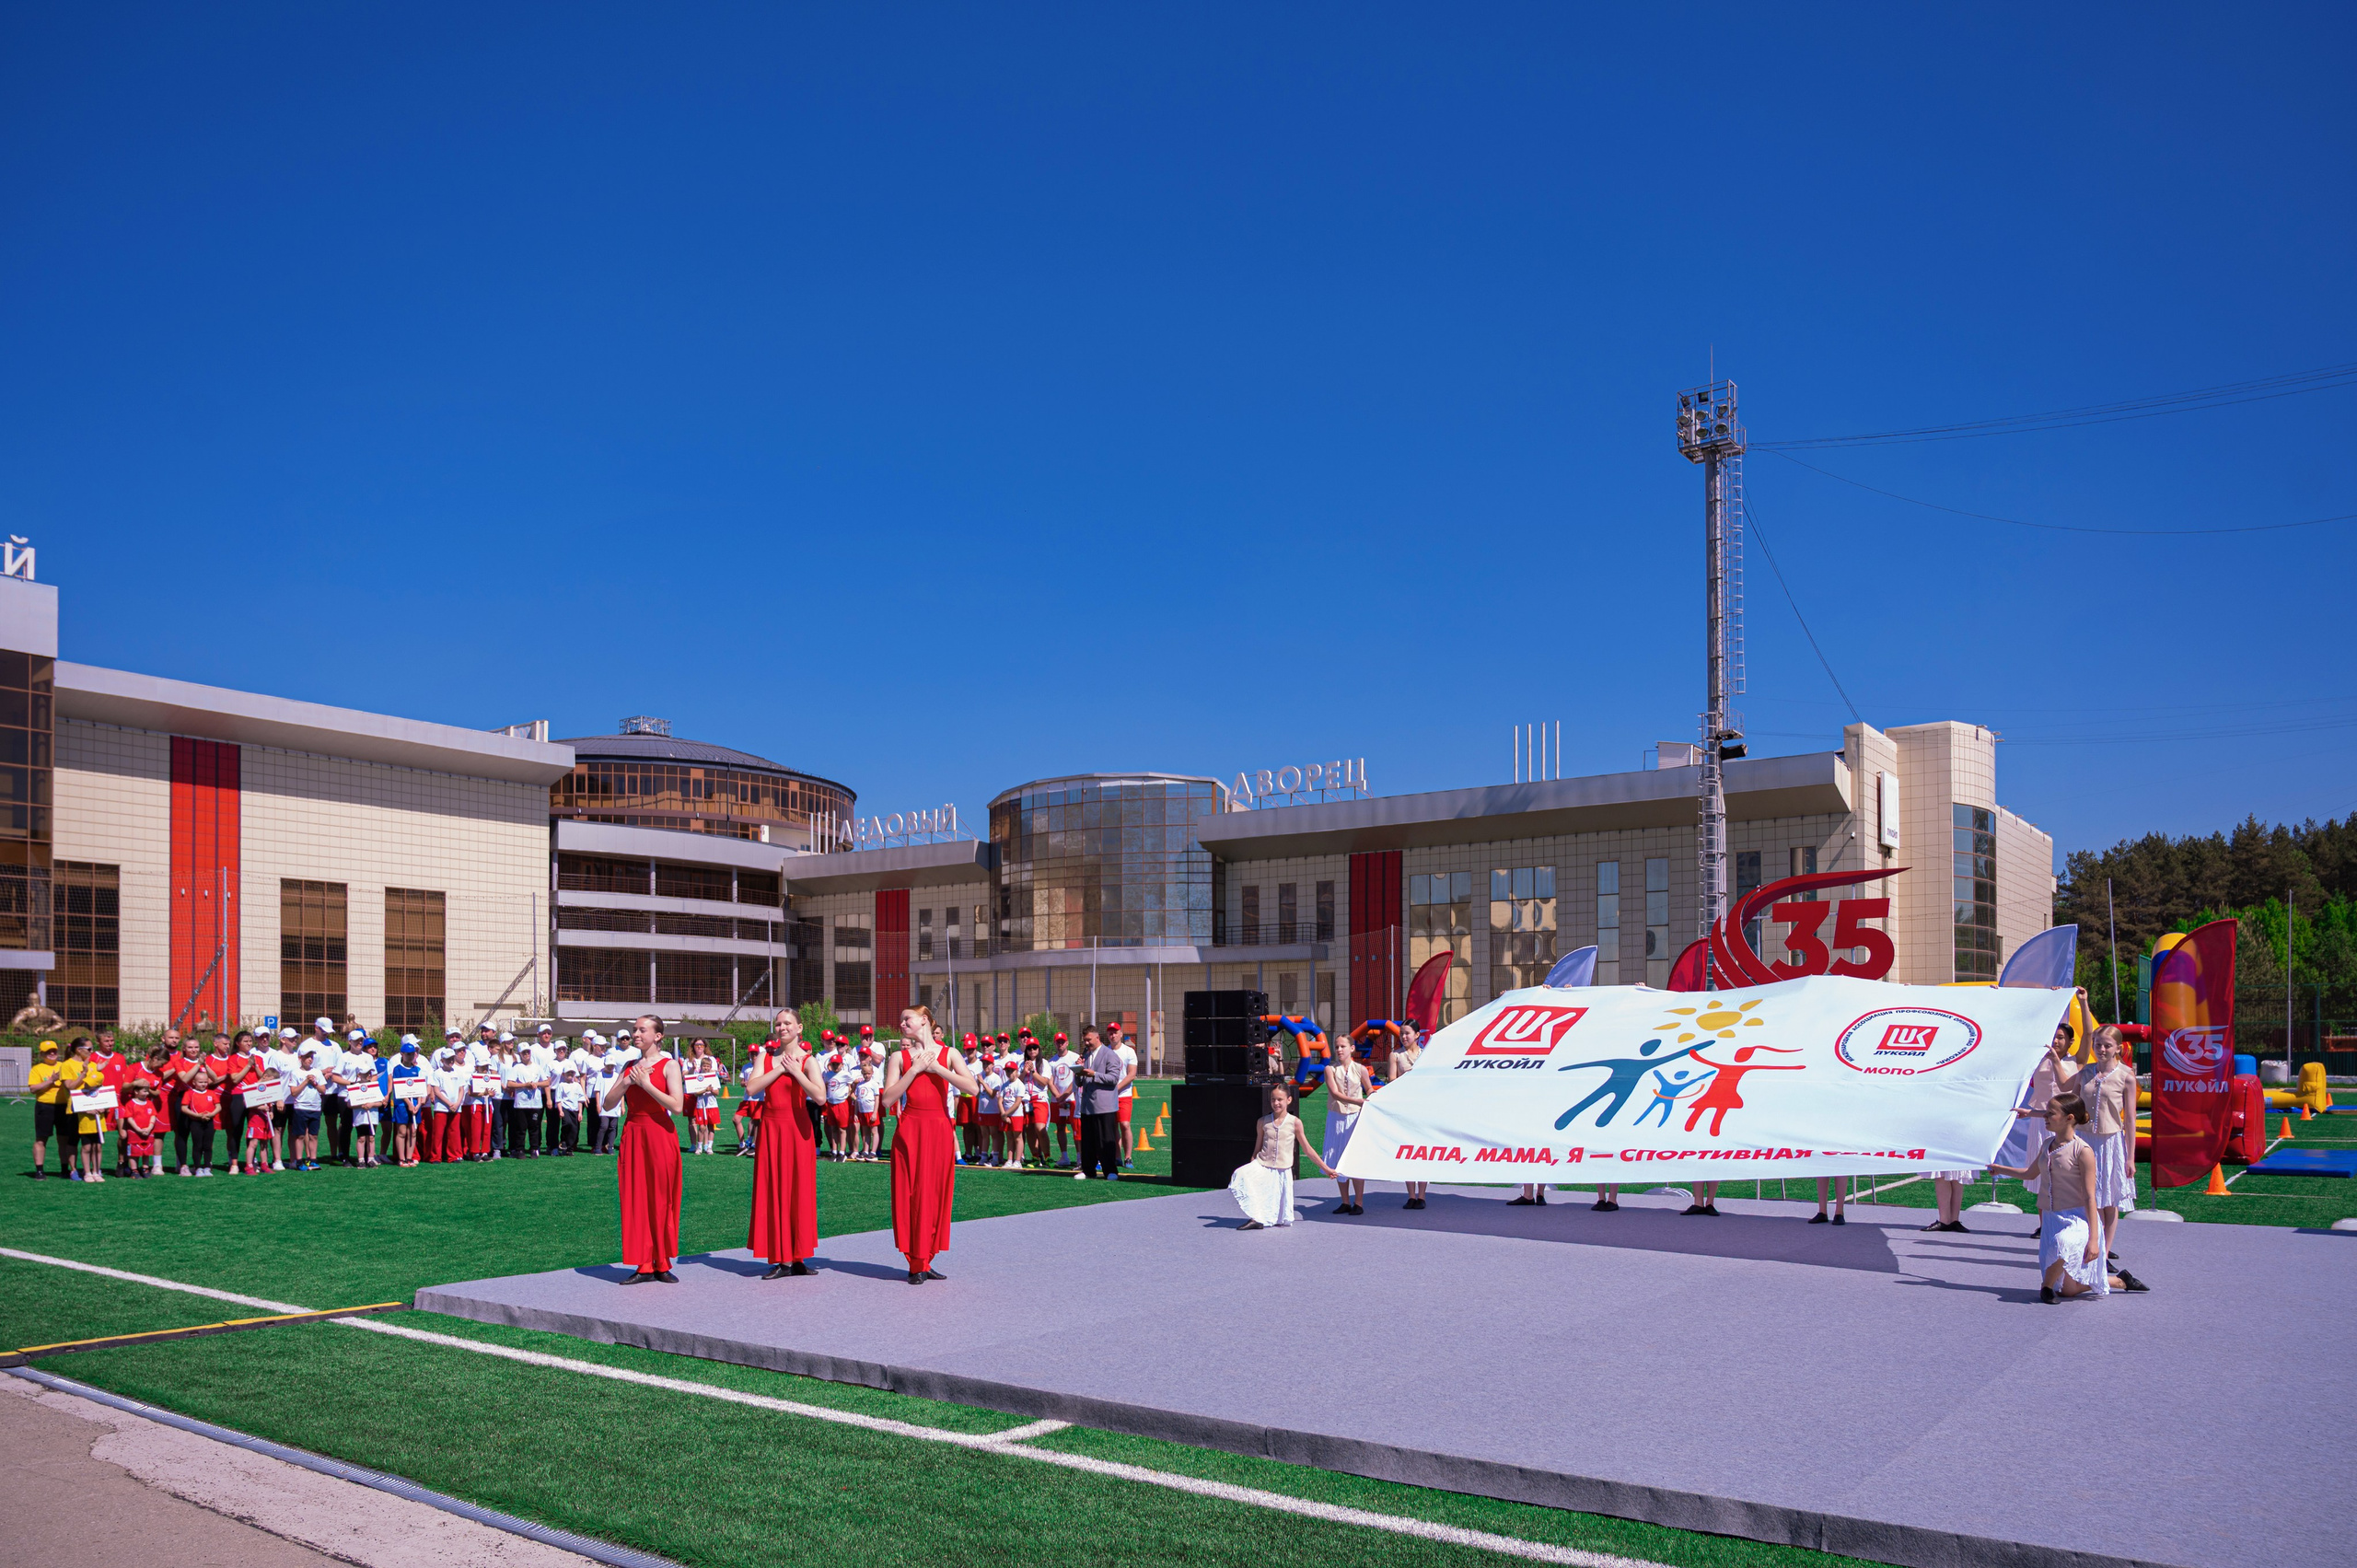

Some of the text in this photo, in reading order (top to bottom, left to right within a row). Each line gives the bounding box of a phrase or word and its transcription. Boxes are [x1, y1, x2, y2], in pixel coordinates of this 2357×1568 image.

[1228, 758, 1367, 806] ДВОРЕЦ
[838, 802, 957, 844] ЛЕДОВЫЙ
[1769, 897, 1896, 981] 35
[2183, 1033, 2224, 1061] 35
[1454, 1057, 1546, 1070] ЛУКОЙЛ
[1863, 1066, 1915, 1075] МОПО
[1395, 1144, 1469, 1165] ПАПА,
[1474, 1147, 1559, 1167] МАМА,
[1566, 1147, 1585, 1164] Я
[1620, 1147, 1814, 1163] СПОРТИВНАЯ
